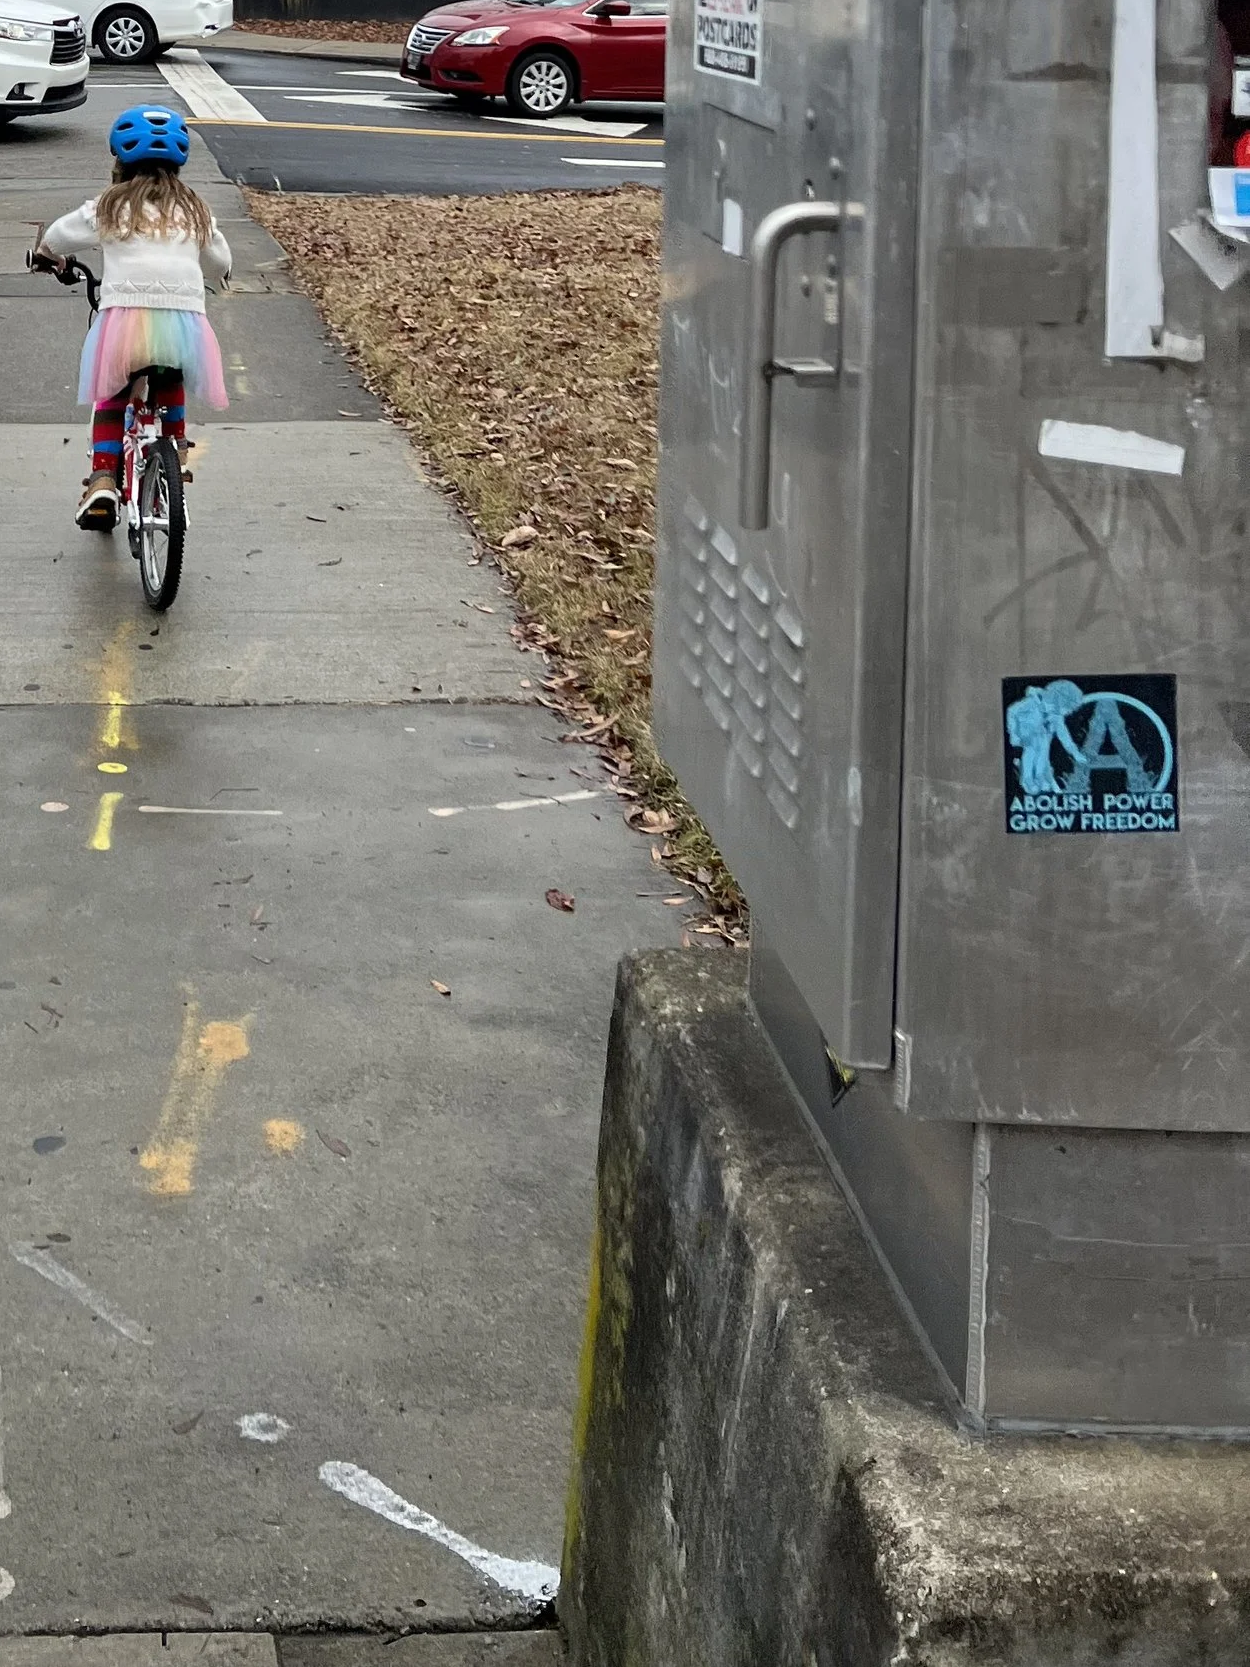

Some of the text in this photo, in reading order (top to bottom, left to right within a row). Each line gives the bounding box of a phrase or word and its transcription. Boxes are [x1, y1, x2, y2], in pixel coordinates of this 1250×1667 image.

[697, 15, 757, 50] POSTCARDS
[1010, 793, 1174, 812] ABOLISH POWER
[1009, 812, 1175, 831] GROW FREEDOM
